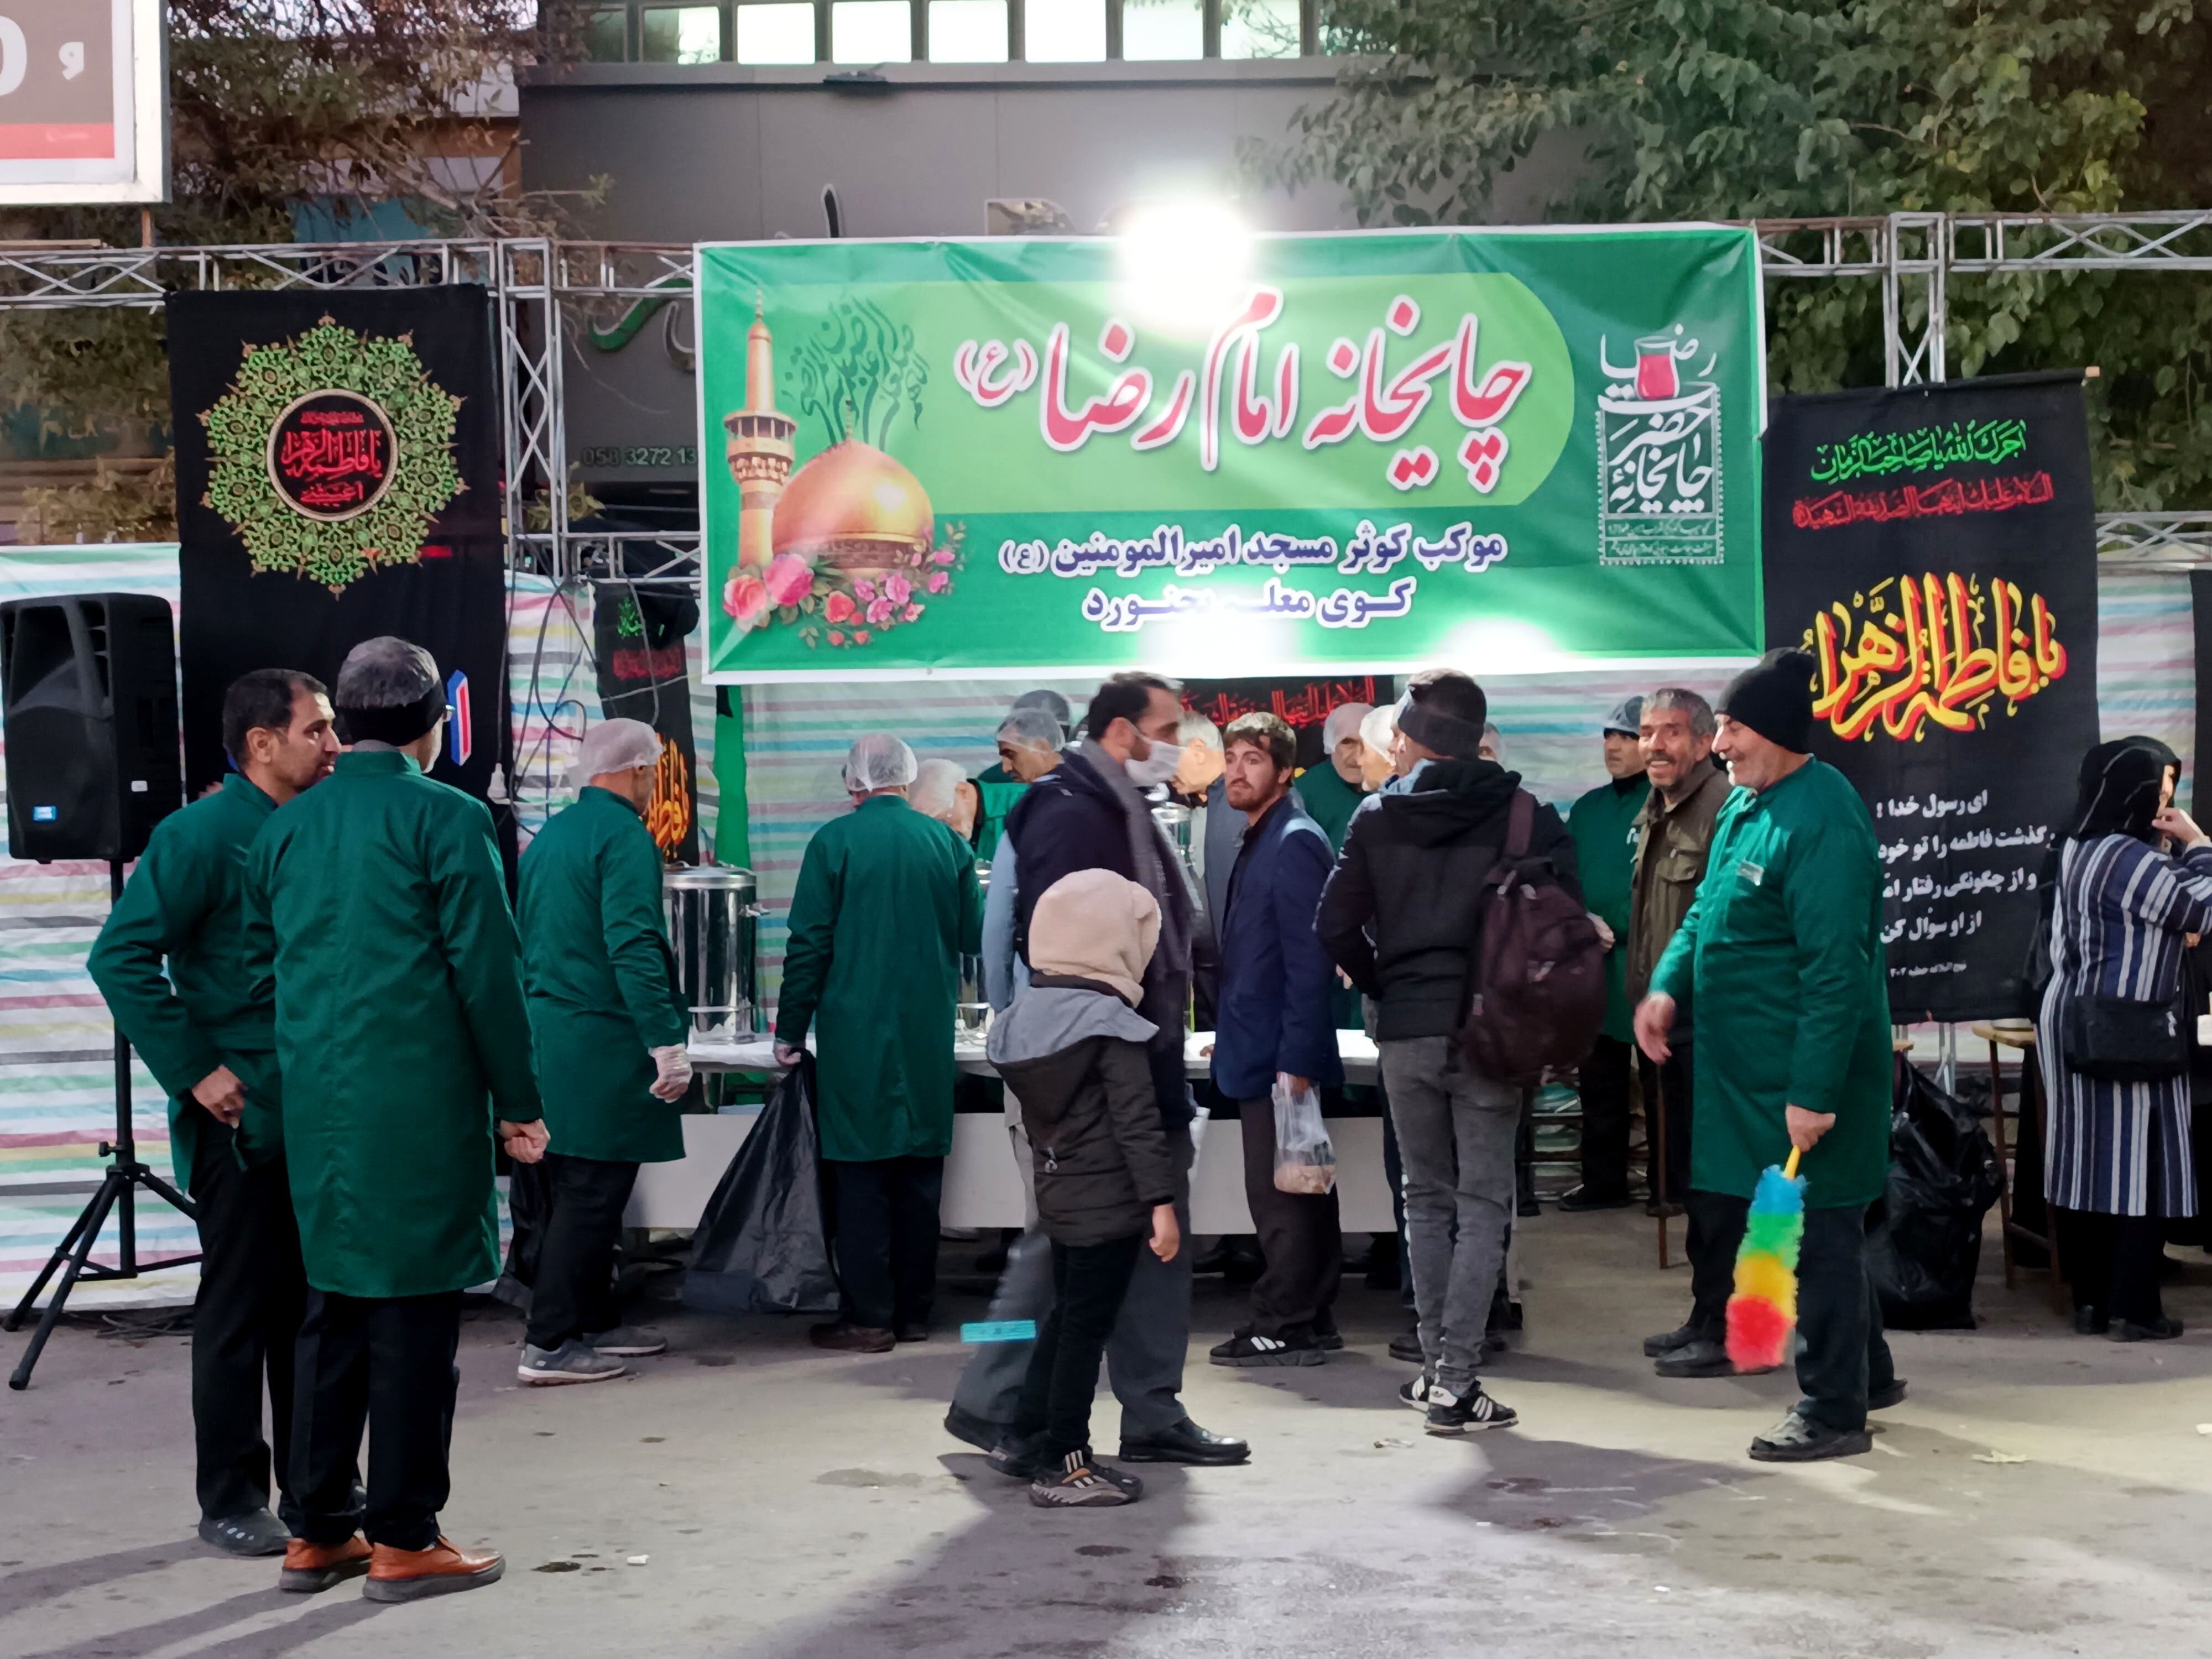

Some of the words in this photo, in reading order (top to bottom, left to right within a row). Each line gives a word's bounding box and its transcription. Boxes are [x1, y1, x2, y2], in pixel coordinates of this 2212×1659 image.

[1043, 320, 1193, 448] رضا
[1204, 288, 1297, 468] امام
[1305, 298, 1529, 490] چایخانه
[625, 447, 672, 466] 3272
[1244, 534, 1336, 570] مسجد
[1341, 522, 1410, 571] کوثر
[1416, 524, 1506, 568] موکب
[1227, 582, 1314, 614] معل
[1318, 580, 1414, 627] کوی
[1922, 793, 1965, 818] رسول
[1967, 789, 1988, 815] ای
[1877, 838, 1909, 864] خود
[1912, 836, 1929, 861] تو
[1932, 834, 1948, 859] را
[1950, 827, 1993, 851] فاطمه
[1901, 874, 1942, 902] رفتار
[1943, 869, 2005, 898] چگونگی
[2006, 867, 2025, 892] از
[2025, 873, 2037, 891] و
[1880, 918, 1907, 944] کن
[1948, 911, 1965, 937] او
[1965, 910, 1983, 935] از
